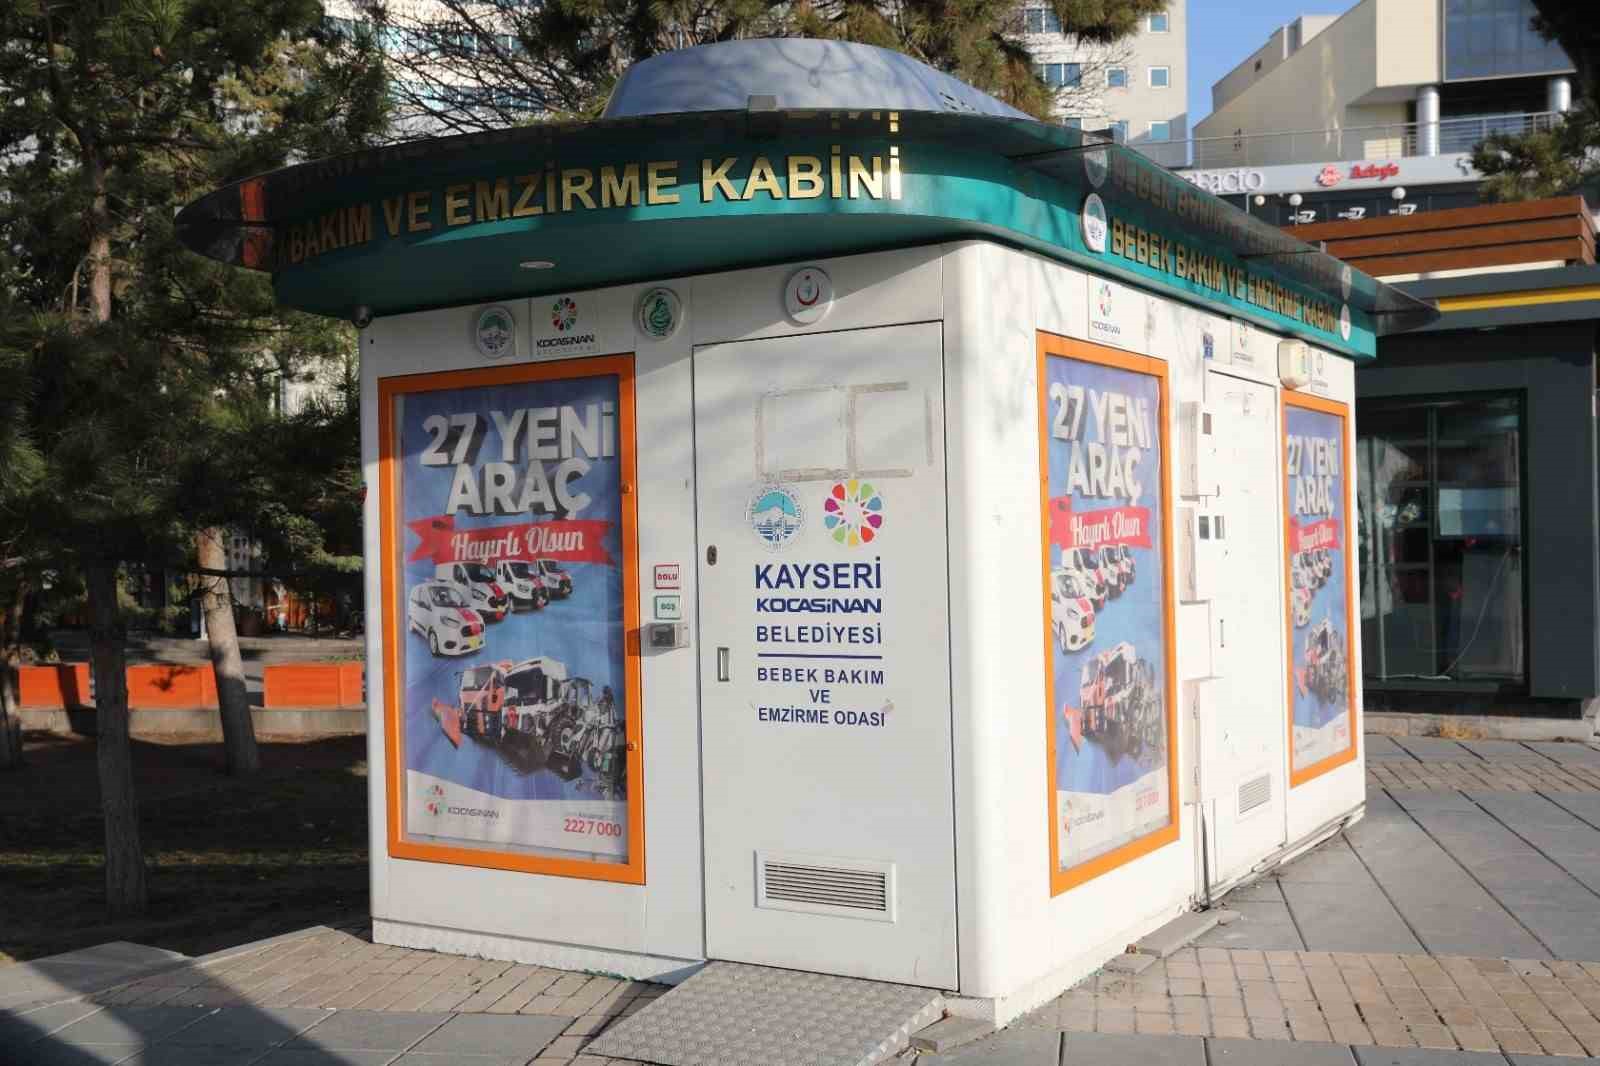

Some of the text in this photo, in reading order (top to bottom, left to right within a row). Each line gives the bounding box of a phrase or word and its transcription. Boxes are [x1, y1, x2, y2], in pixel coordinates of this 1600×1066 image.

[383, 190, 432, 240] VE
[446, 158, 681, 226] EMZİRME
[703, 145, 901, 202] KABİNİ
[1112, 216, 1171, 273] BEBEK
[1175, 242, 1222, 293] BAKIM
[1050, 382, 1085, 441] 27
[421, 412, 478, 465] 27
[446, 457, 592, 520] ARAÇ
[1066, 440, 1142, 507] ARAÇ
[525, 527, 585, 555] Olsun
[657, 572, 678, 581] DOLU
[755, 556, 882, 589] KAYSERİ
[756, 622, 882, 644] BELEDİYESİ
[757, 667, 884, 686] BEBEK BAKIM
[809, 688, 831, 704] VE
[758, 705, 886, 728] EMZİRME ODASI
